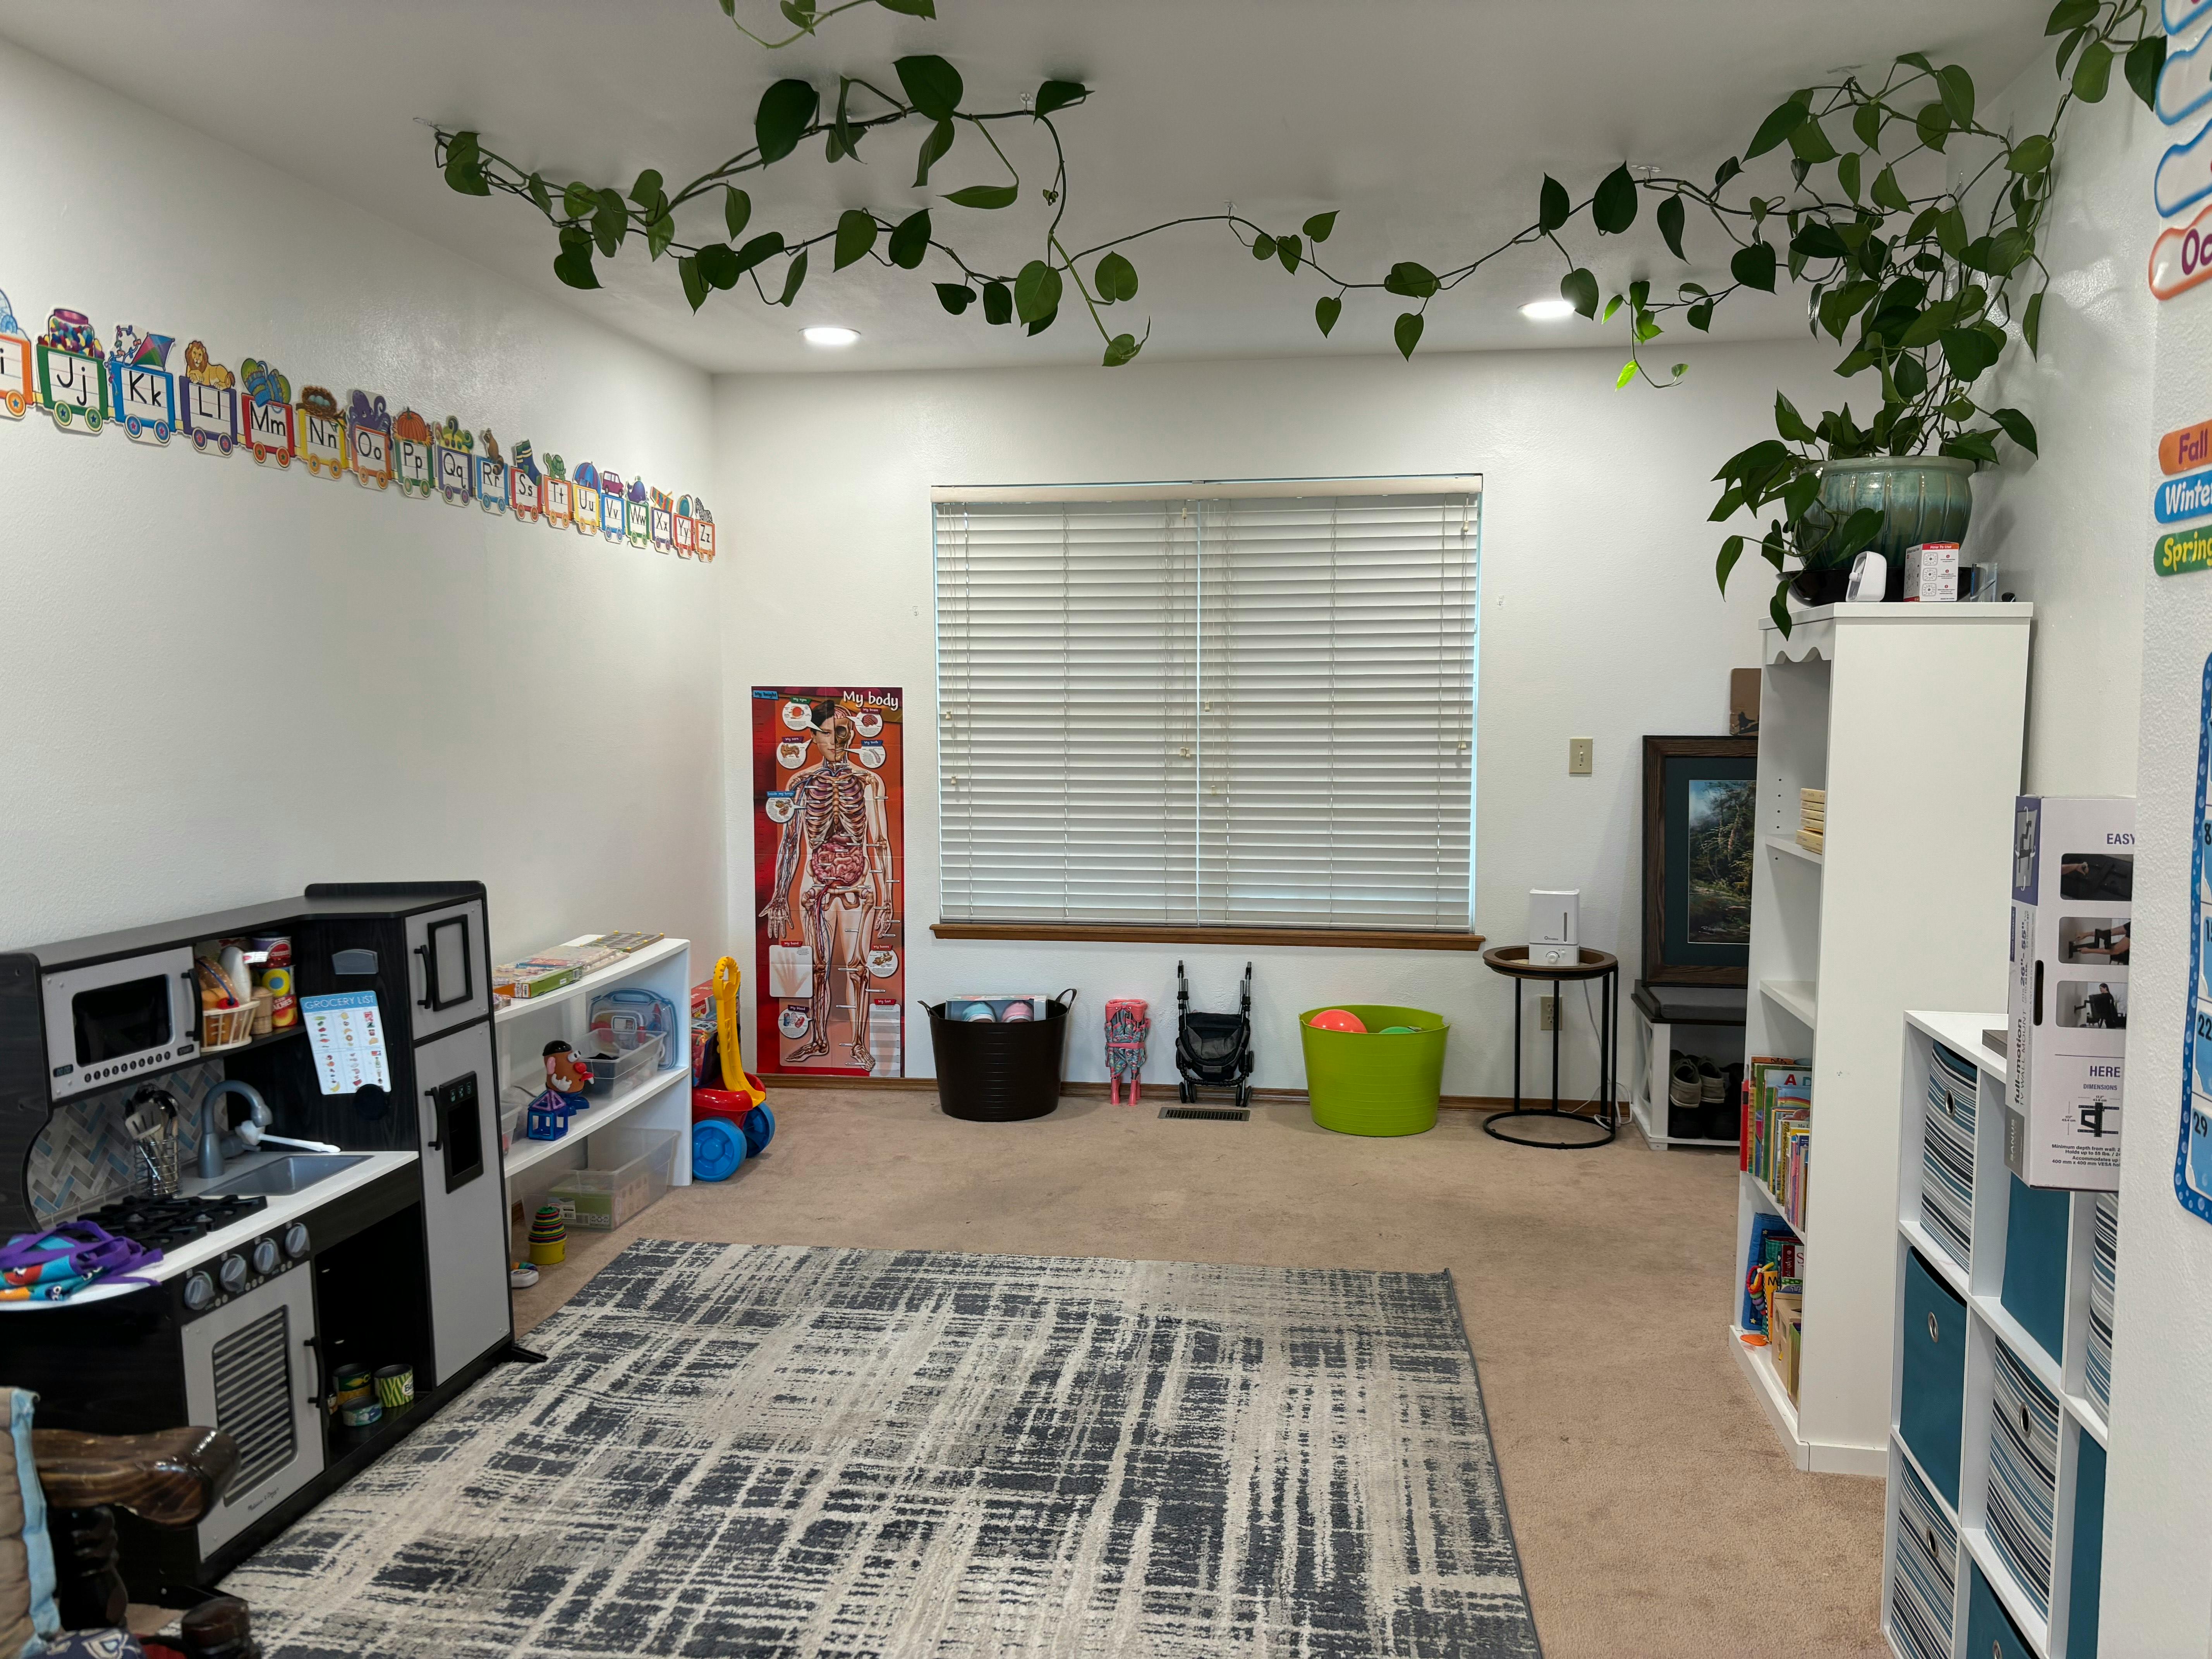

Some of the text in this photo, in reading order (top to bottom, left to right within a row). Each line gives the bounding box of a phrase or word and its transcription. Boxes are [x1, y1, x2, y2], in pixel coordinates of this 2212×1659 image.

[57, 357, 88, 406] Jj
[130, 370, 161, 407] Kk
[198, 386, 221, 420] Ll
[250, 401, 286, 436] Mm
[310, 416, 337, 449] Nn
[358, 431, 382, 460] Oo
[2178, 428, 2208, 465] Fall
[403, 442, 422, 479] Pp
[443, 452, 466, 489] Qq
[483, 462, 500, 487] Rr
[519, 474, 533, 496] Ss
[551, 481, 563, 504] Tt
[579, 489, 594, 512] Uu
[2166, 479, 2212, 515] Winte
[606, 498, 618, 519] Vv
[630, 504, 646, 526] Ww
[656, 511, 668, 532] Xx
[678, 519, 689, 544] Yy
[700, 524, 710, 543] Zz
[2163, 531, 2212, 572] Spring
[843, 690, 898, 711] My body
[2107, 834, 2135, 845] EASY
[2205, 823, 2212, 845] 8
[305, 995, 374, 1009] GROCERY LIST
[2198, 1014, 2212, 1041] 22
[2014, 1019, 2023, 1104] full-motion
[2090, 1066, 2121, 1078] HERE
[1784, 1074, 1797, 1085] A
[2193, 1111, 2207, 1138] 29
